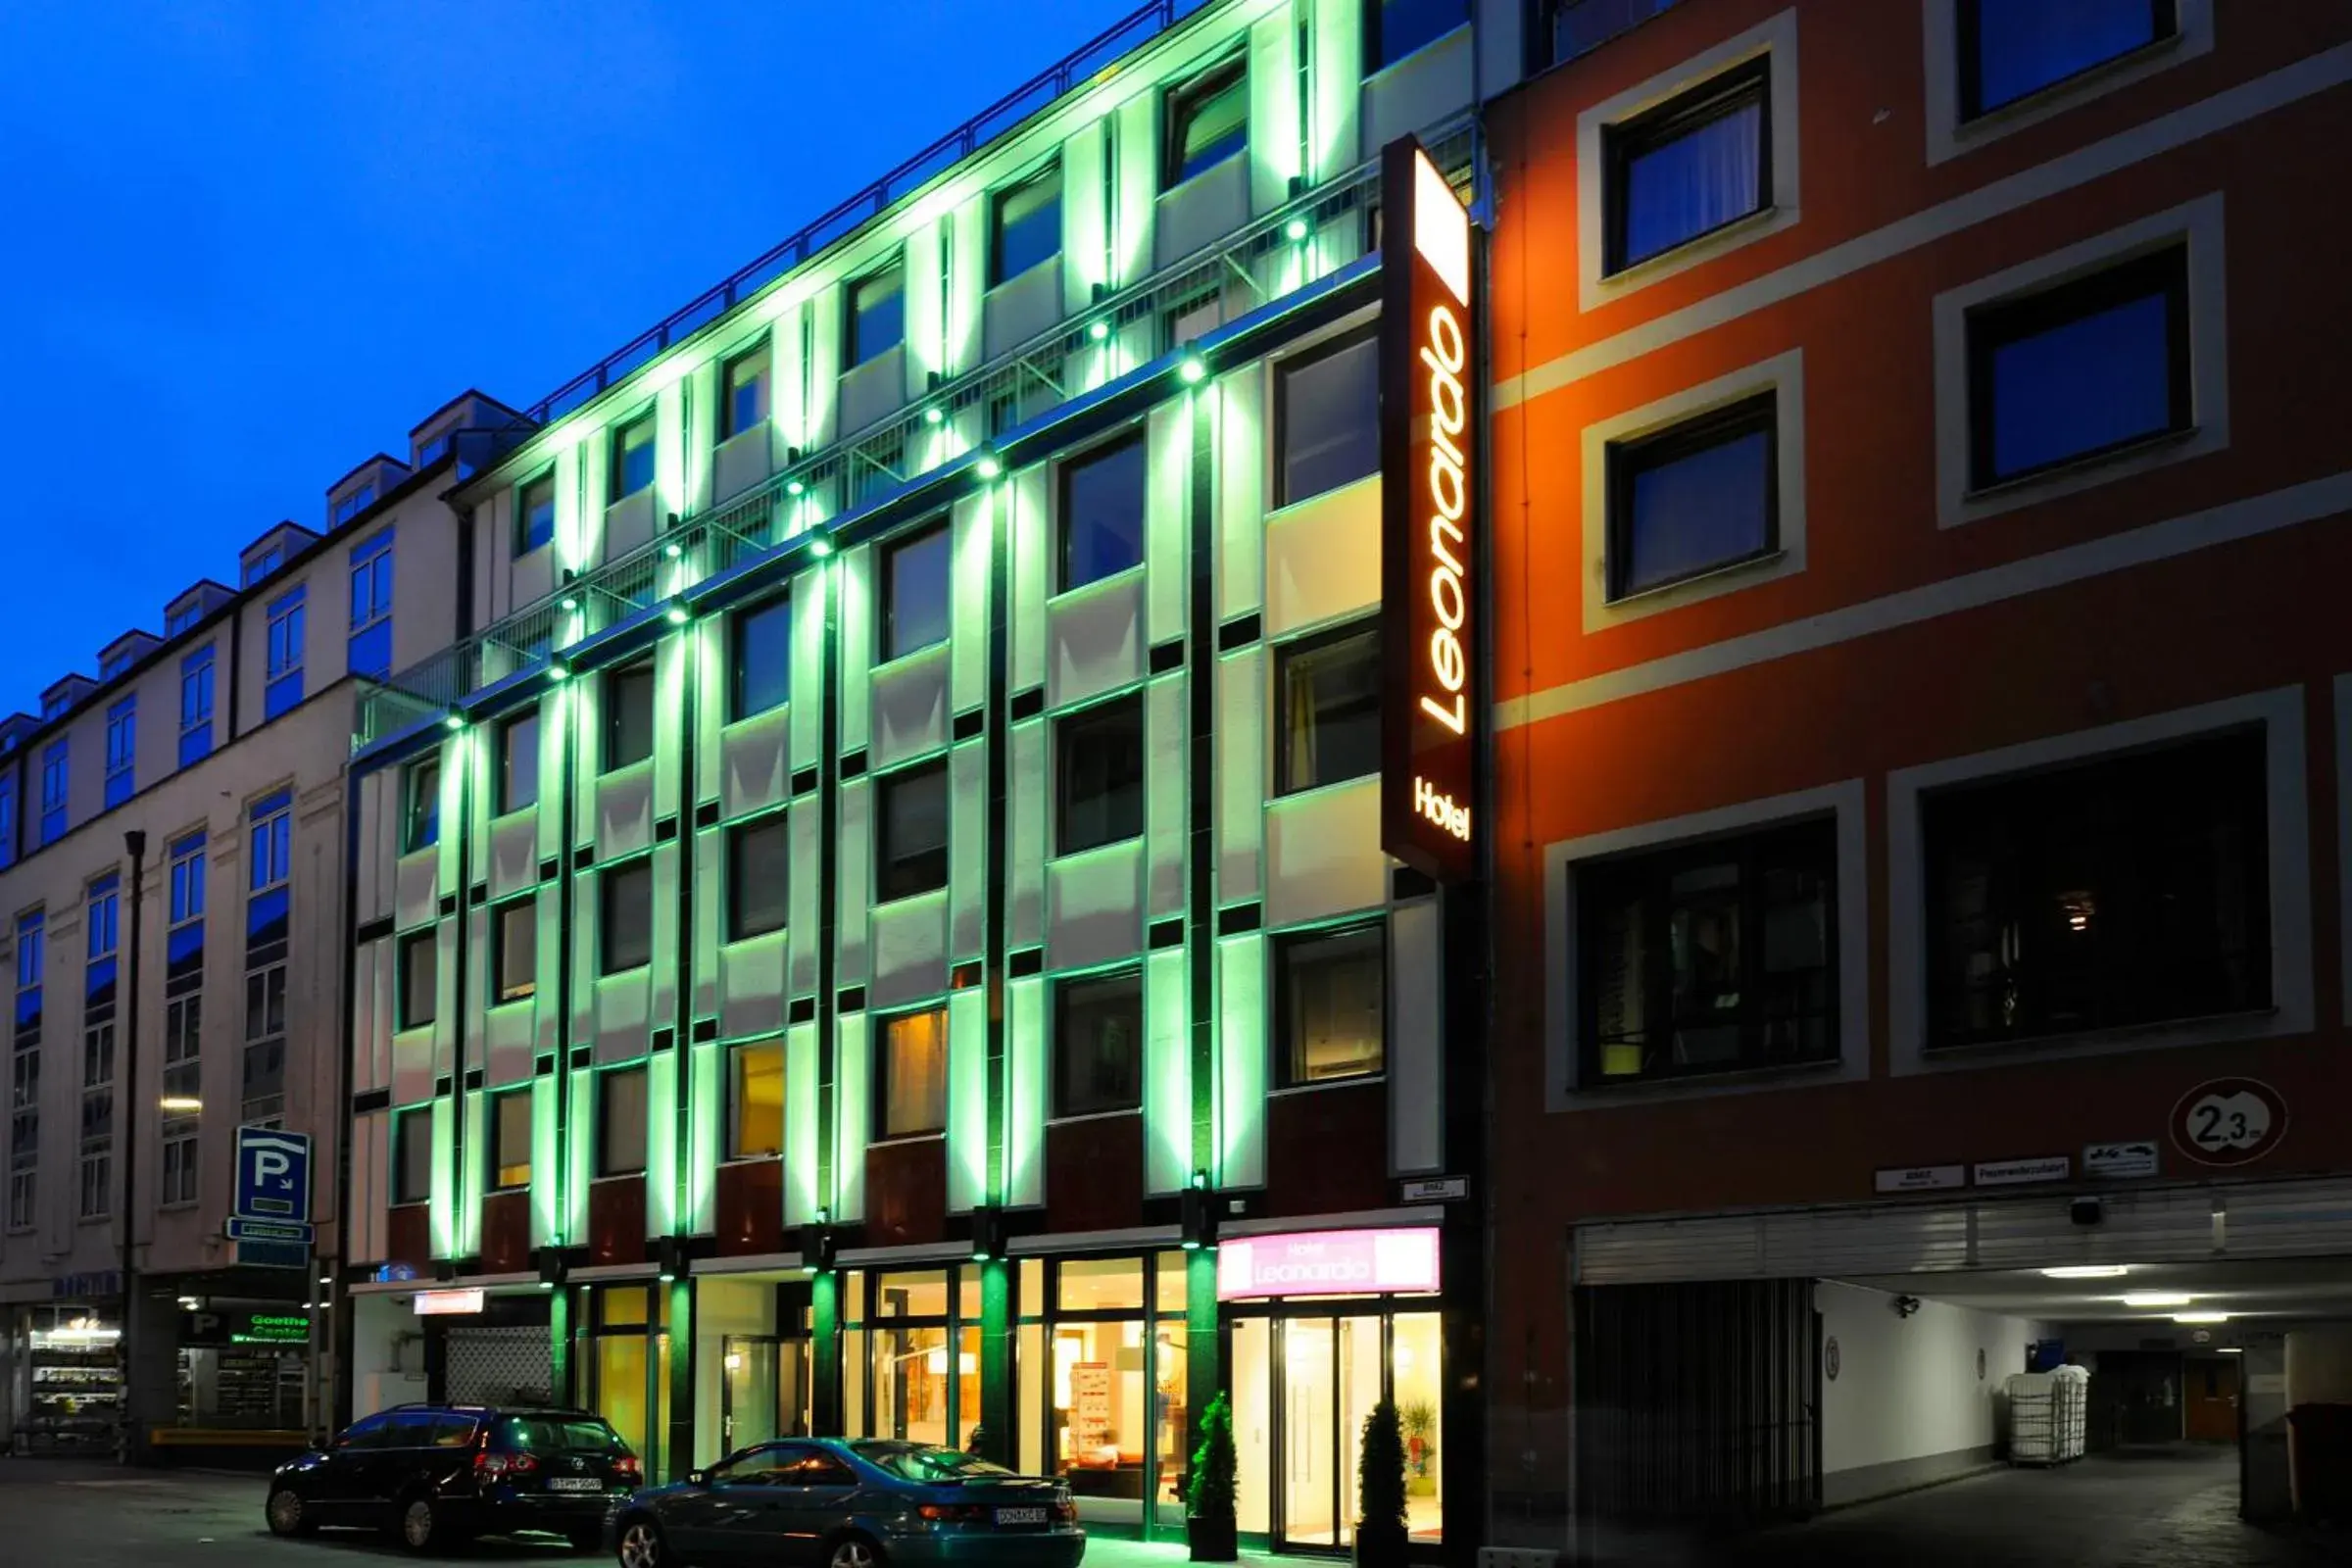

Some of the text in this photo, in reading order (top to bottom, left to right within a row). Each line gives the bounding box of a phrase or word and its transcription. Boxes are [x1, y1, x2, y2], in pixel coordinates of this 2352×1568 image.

[1420, 304, 1466, 736] Leonardo
[1414, 775, 1469, 842] Hotel
[2196, 1105, 2246, 1142] 2.3
[255, 1151, 290, 1187] P
[1254, 1257, 1369, 1285] Leonardo
